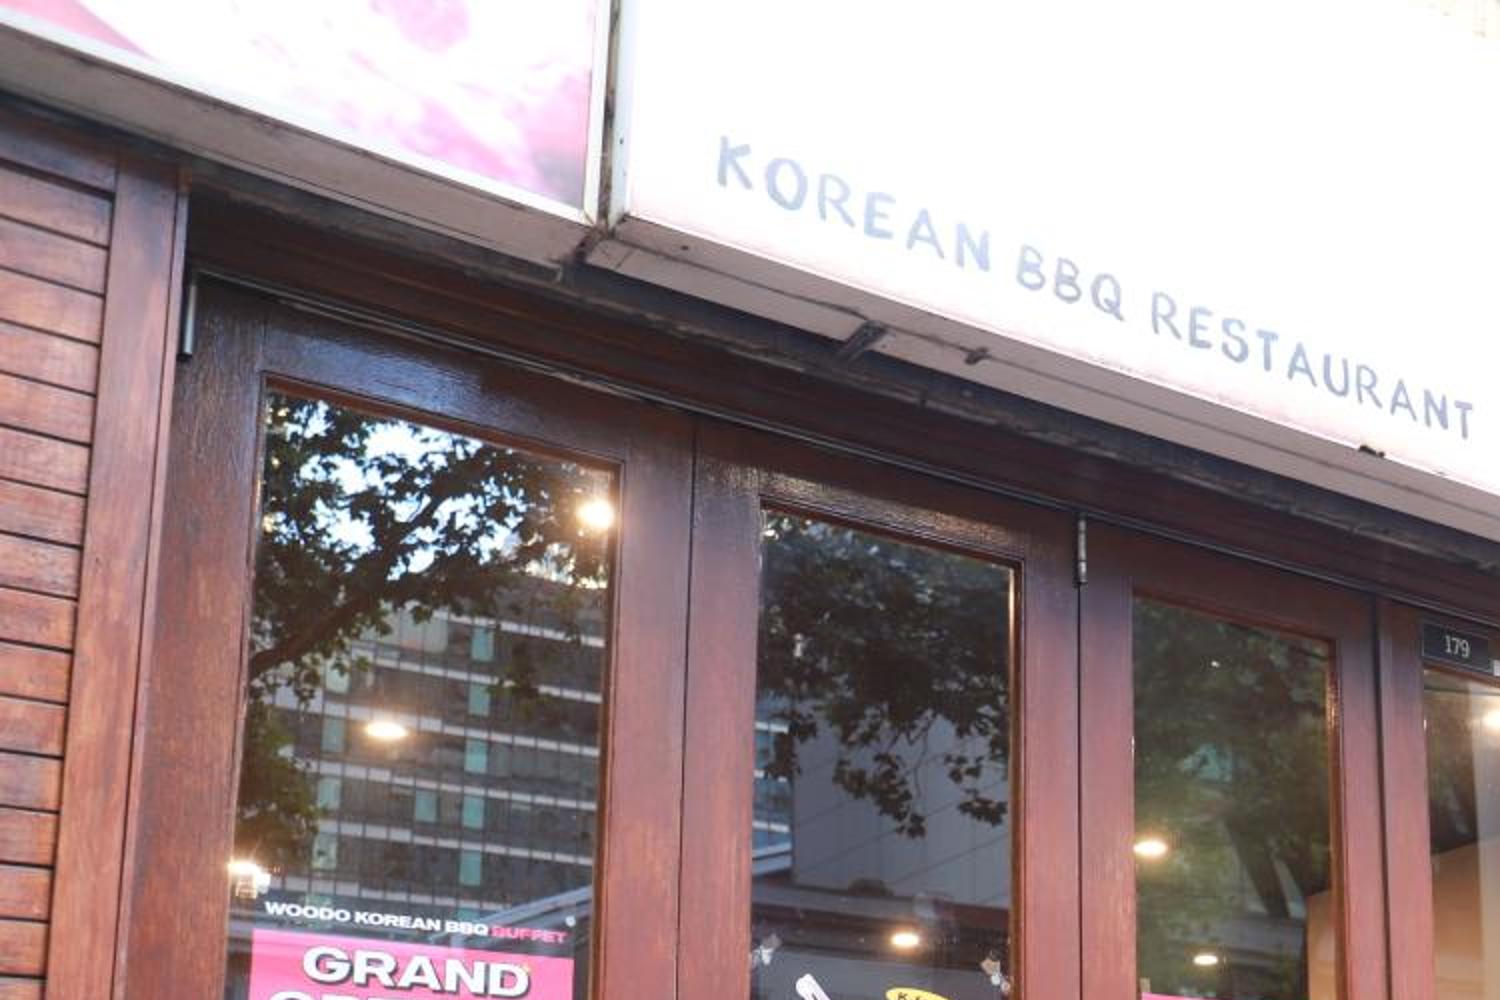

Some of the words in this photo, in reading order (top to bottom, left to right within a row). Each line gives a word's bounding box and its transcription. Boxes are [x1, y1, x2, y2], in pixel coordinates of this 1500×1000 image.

[715, 135, 993, 273] KOREAN
[1016, 244, 1125, 323] BBQ
[1151, 291, 1475, 441] RESTAURANT
[1445, 634, 1471, 659] 179
[265, 901, 350, 923] WOODO
[354, 909, 441, 932] KOREAN
[445, 921, 489, 936] BBQ
[491, 925, 568, 944] BUFFET
[302, 946, 530, 998] GRAND
